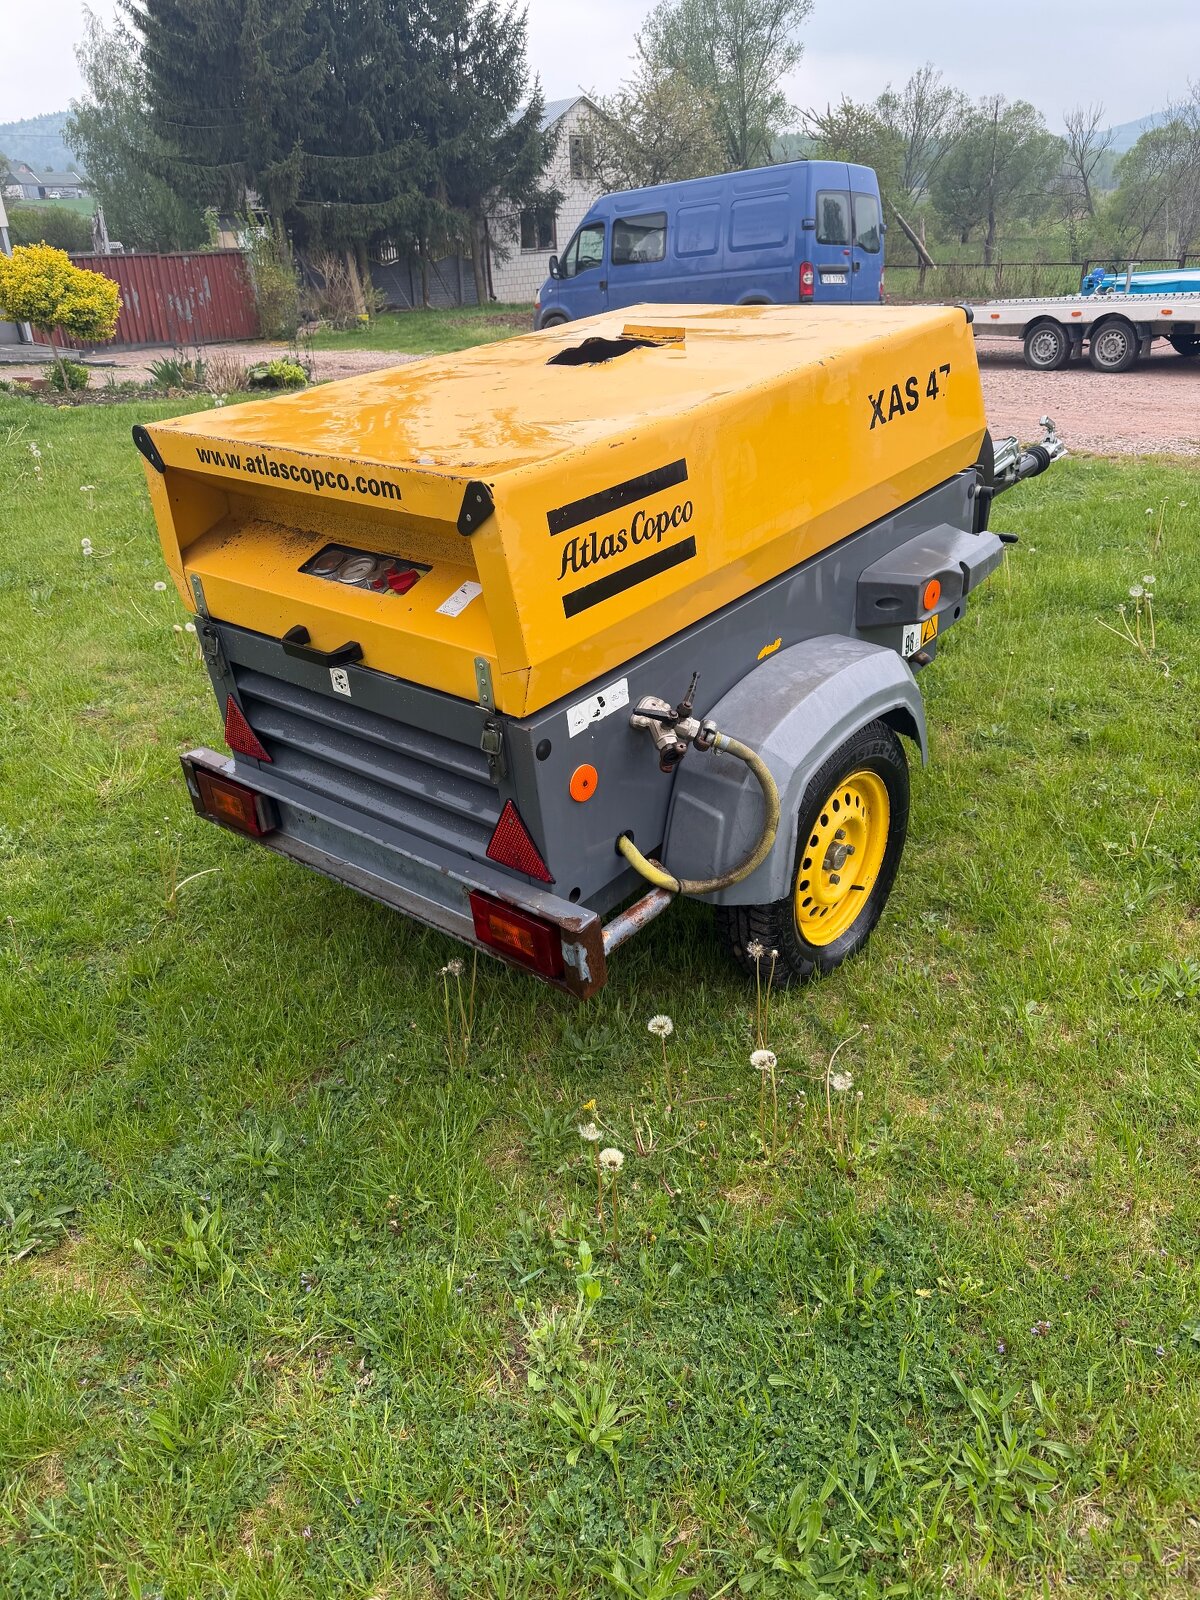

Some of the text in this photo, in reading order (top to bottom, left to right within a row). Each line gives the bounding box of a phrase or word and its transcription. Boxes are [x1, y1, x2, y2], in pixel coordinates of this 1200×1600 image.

[867, 376, 920, 431] XAS
[195, 447, 403, 500] www.atlascopco.com
[556, 500, 694, 581] Atlas Copco
